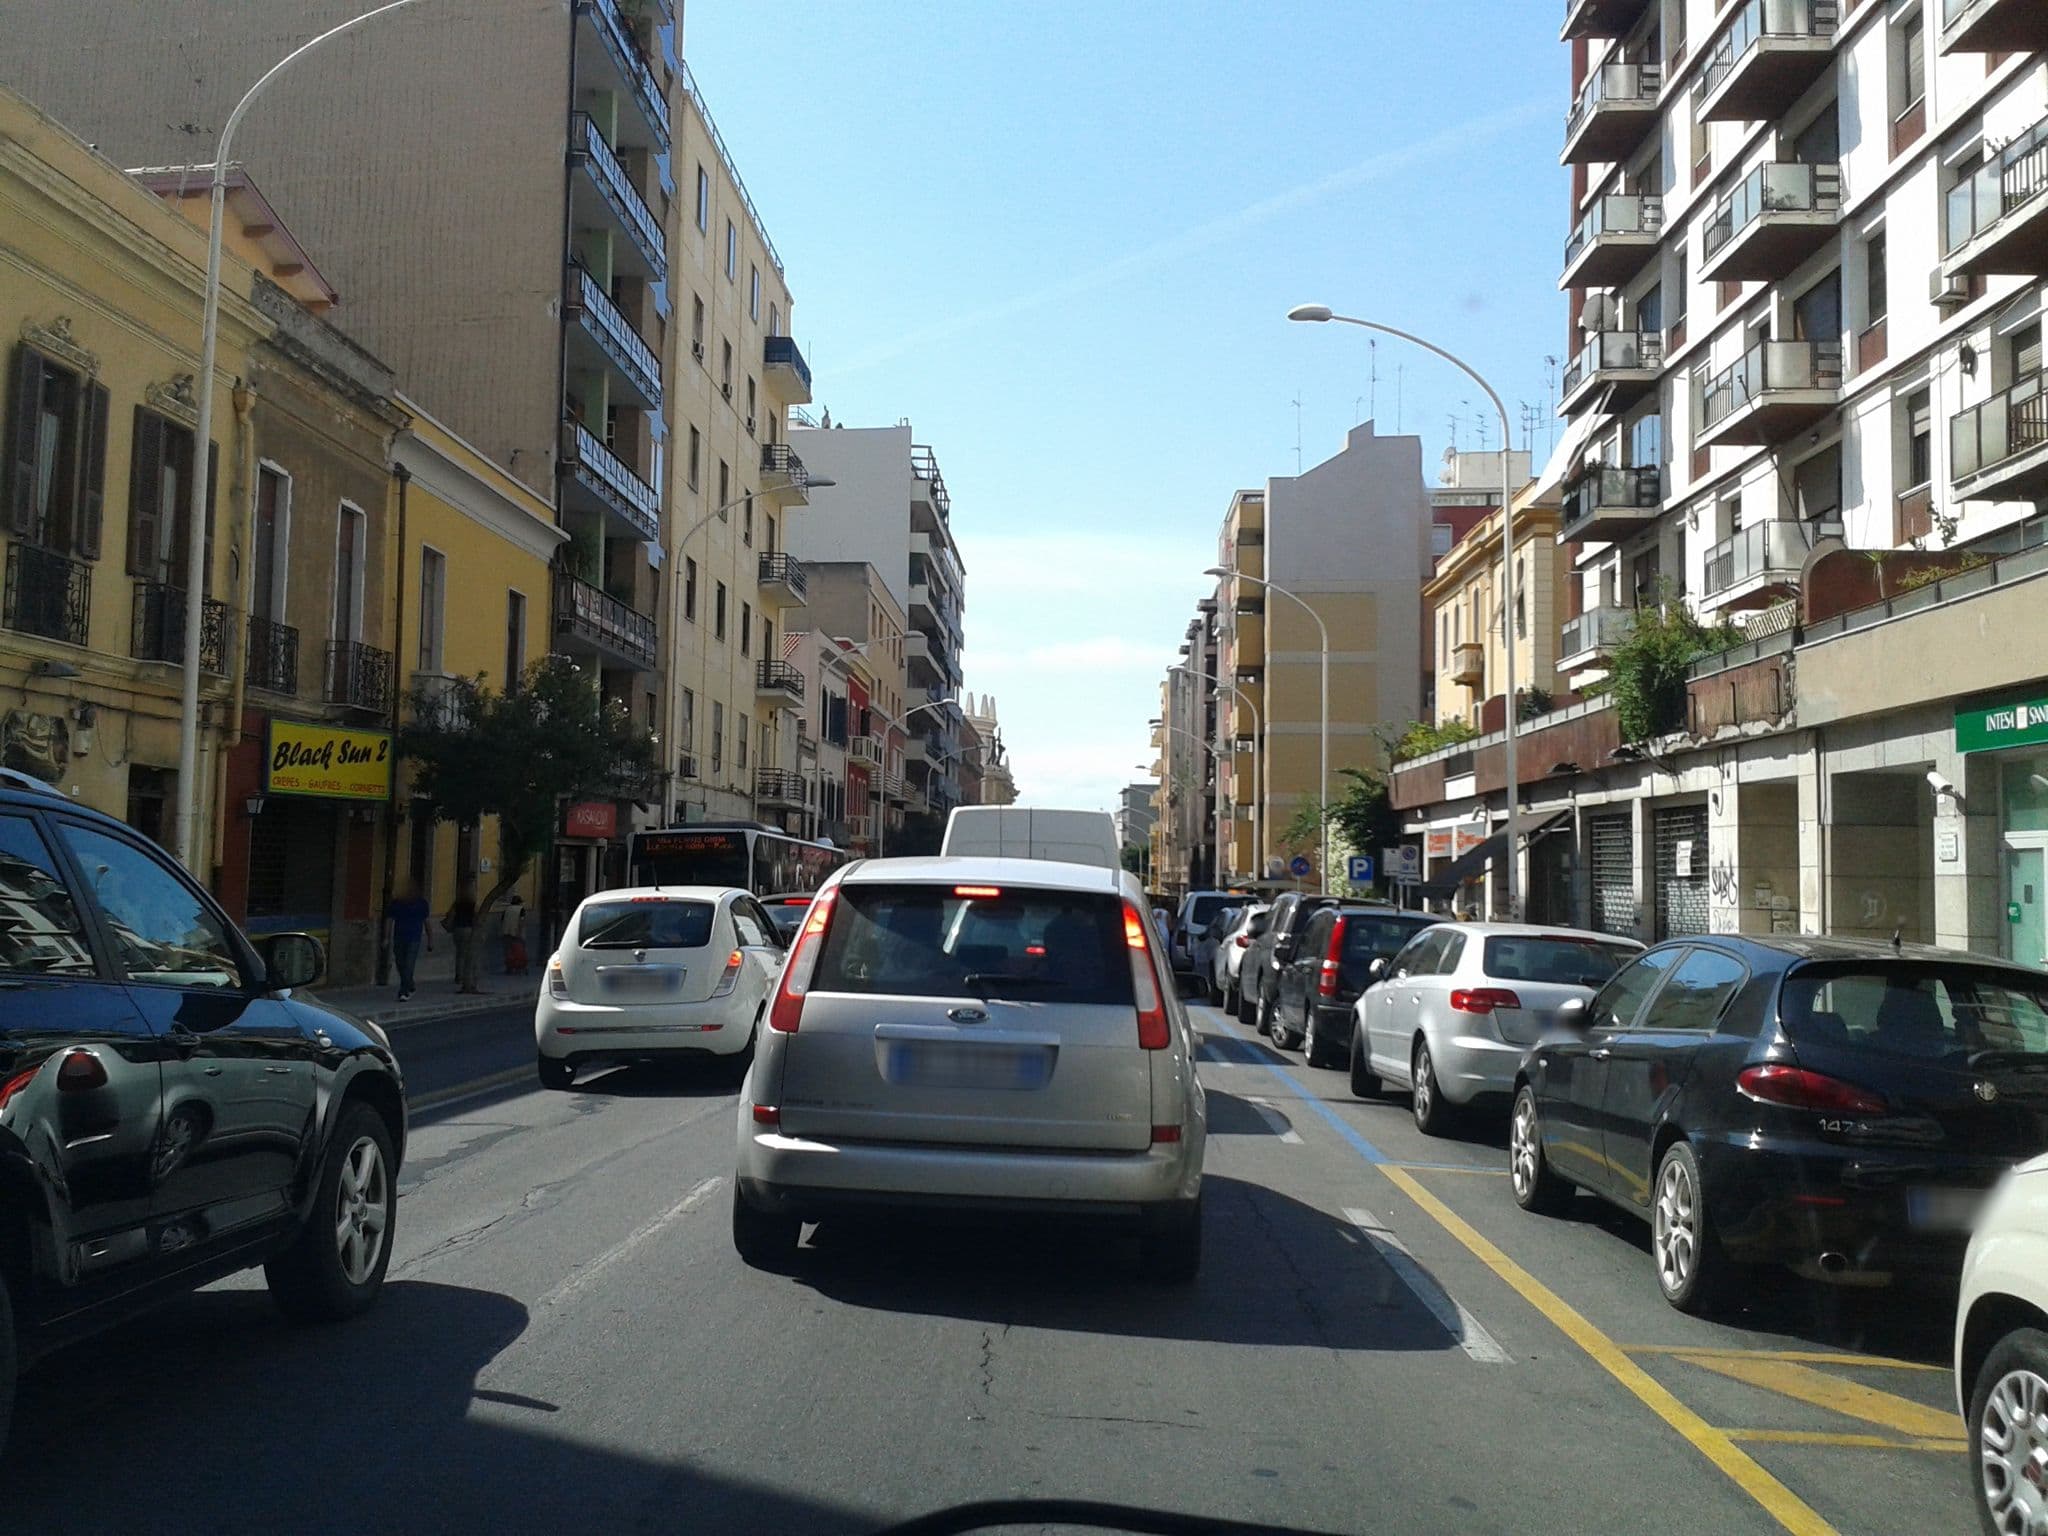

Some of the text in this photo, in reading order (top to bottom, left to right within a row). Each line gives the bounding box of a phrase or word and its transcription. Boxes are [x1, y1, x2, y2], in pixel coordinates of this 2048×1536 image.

[1986, 711, 2015, 731] INTESA
[273, 739, 388, 771] Black Sun 2
[1352, 858, 1369, 878] P
[1819, 1118, 1855, 1132] 147
